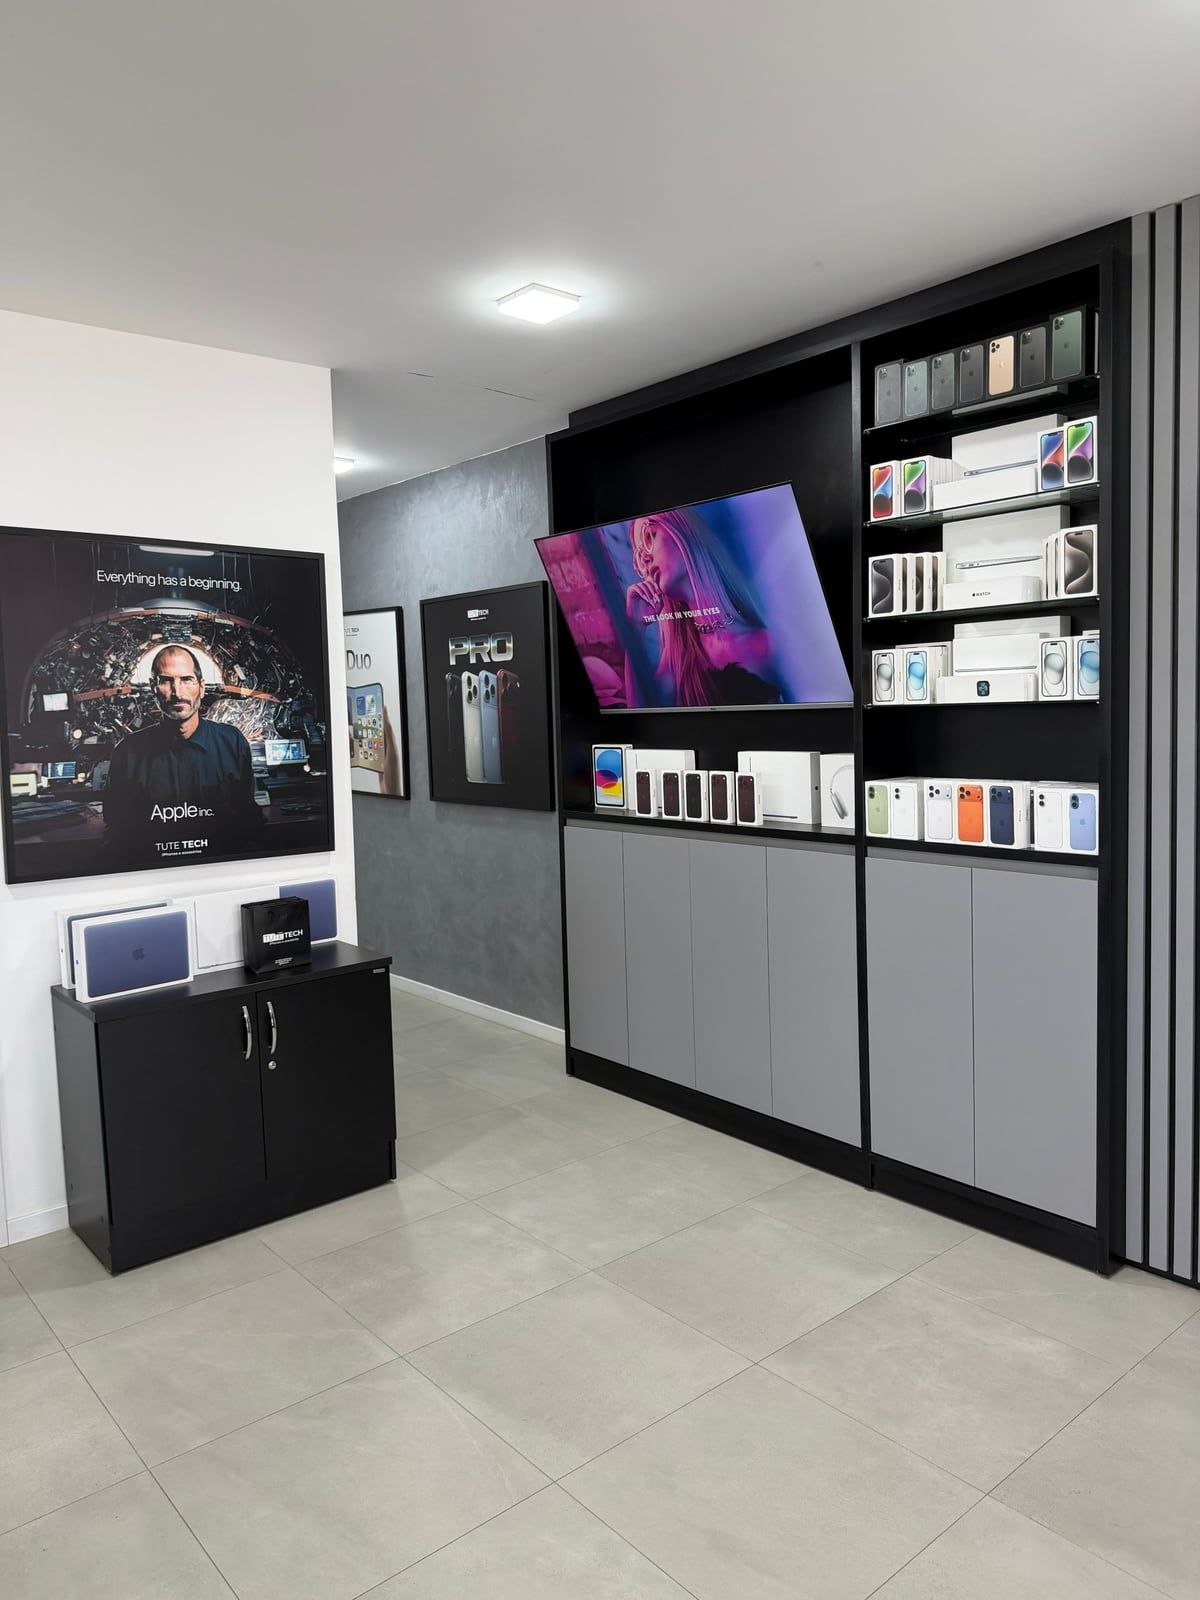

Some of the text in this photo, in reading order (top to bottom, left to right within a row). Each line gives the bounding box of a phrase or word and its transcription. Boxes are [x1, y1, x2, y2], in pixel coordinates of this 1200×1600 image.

[97, 570, 243, 592] Everything has a beginning.
[643, 607, 720, 623] THE LOOK IN YOUR EYES
[346, 649, 372, 671] Duo
[449, 632, 514, 666] PRO
[150, 801, 215, 823] Apple inc.
[155, 838, 208, 852] TUTE TECH
[284, 929, 303, 938] TECH
